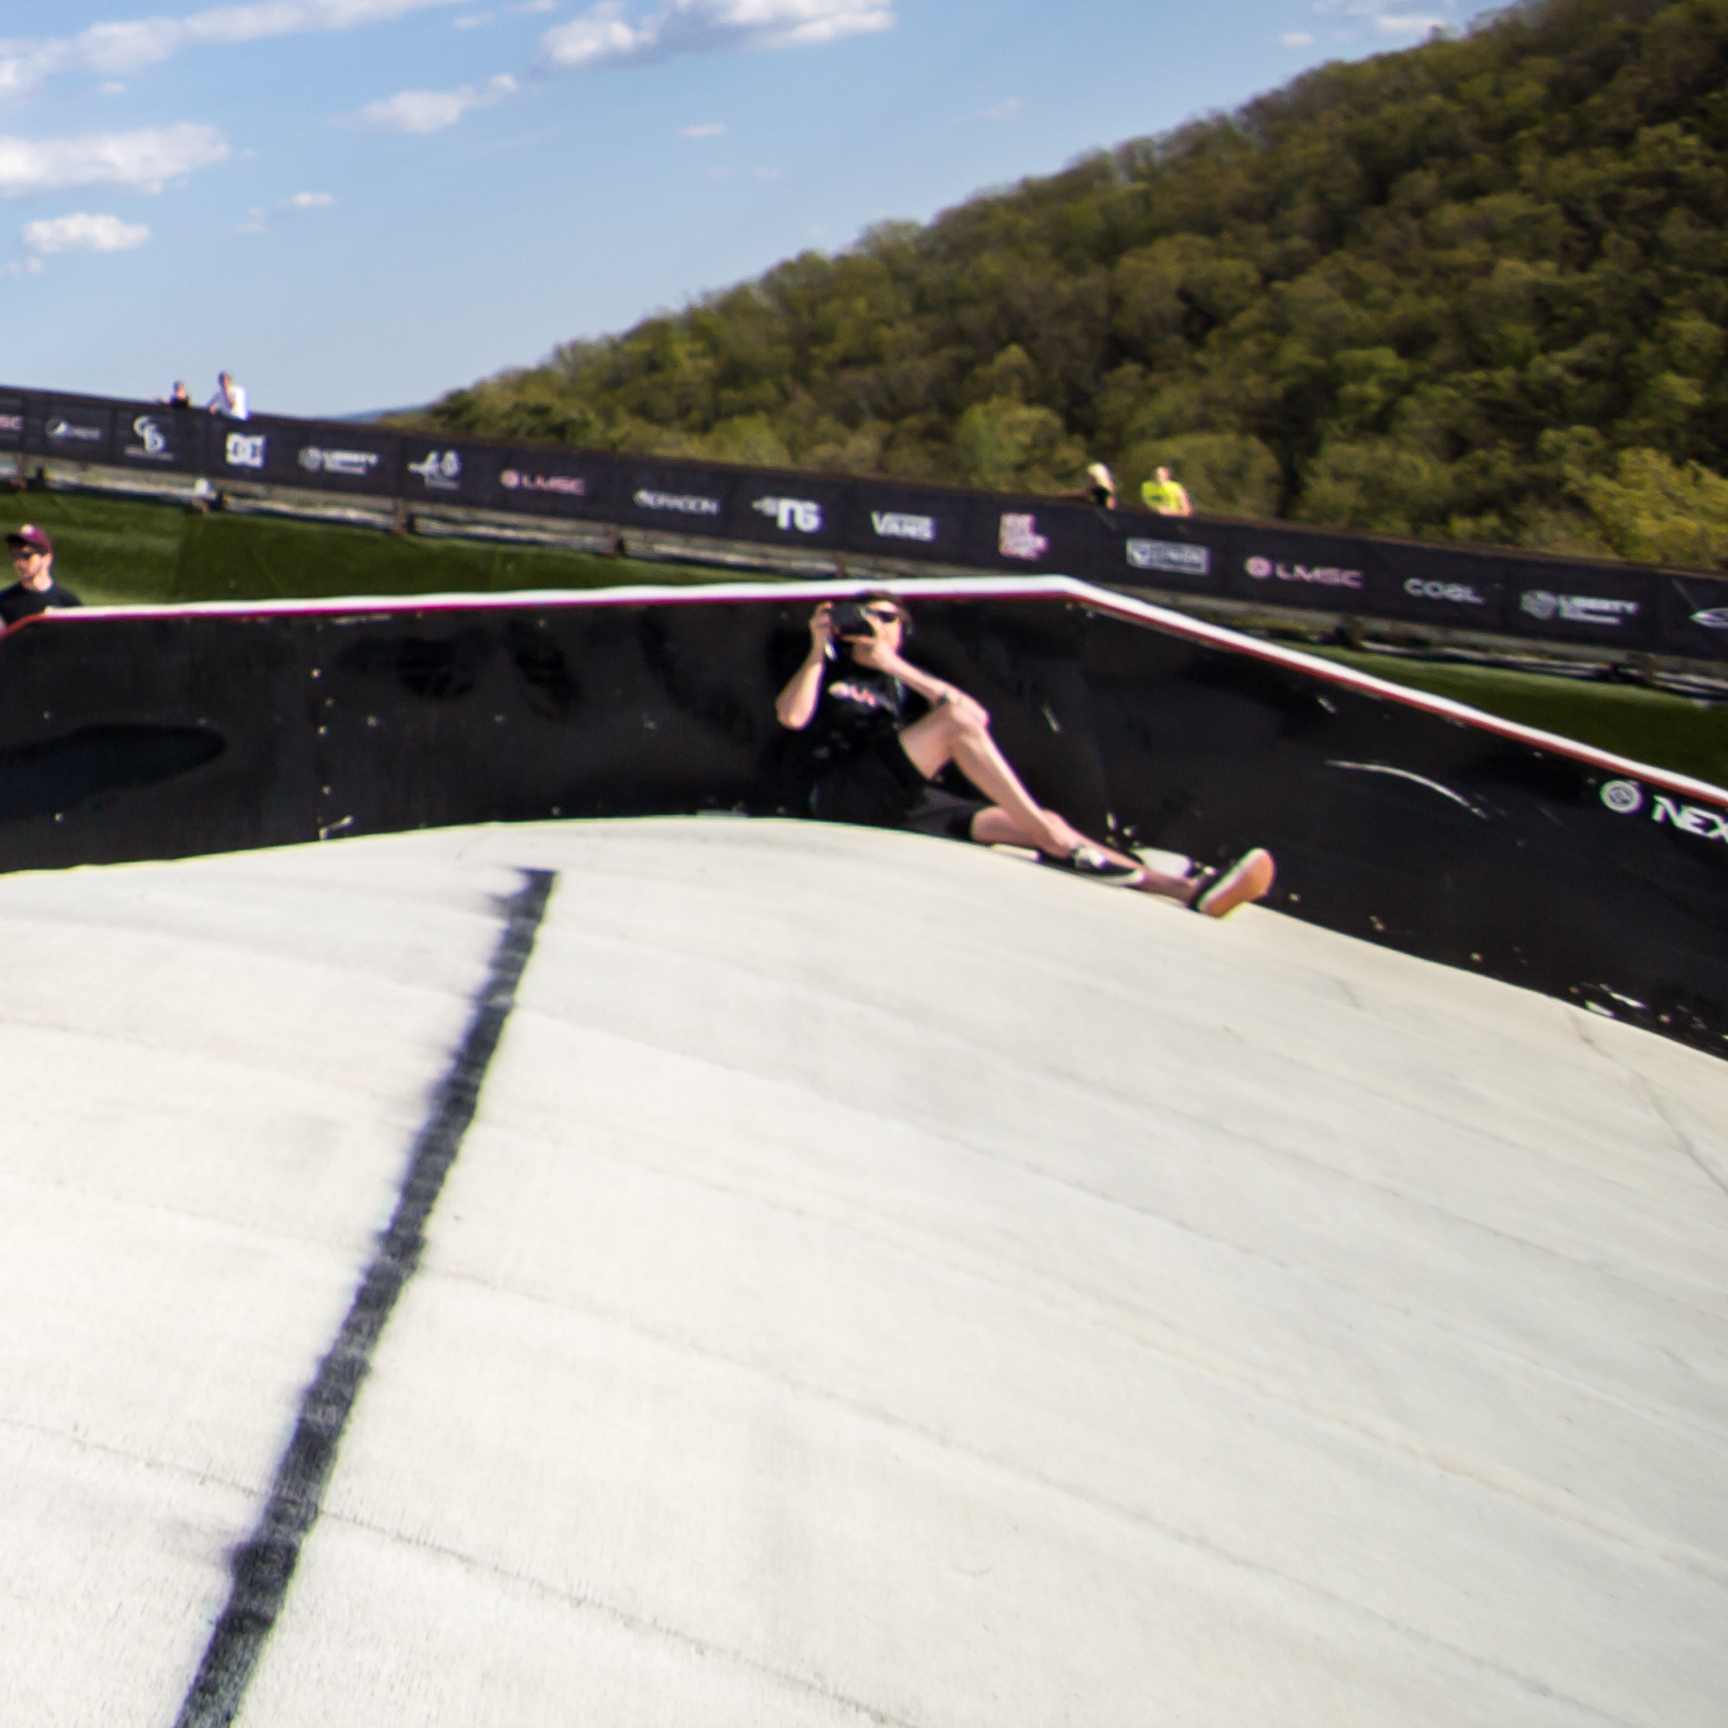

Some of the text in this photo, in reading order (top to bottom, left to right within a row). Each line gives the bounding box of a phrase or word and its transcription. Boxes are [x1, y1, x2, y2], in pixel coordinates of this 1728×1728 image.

[520, 473, 586, 497] LMSC
[870, 510, 935, 543] VANS
[1275, 562, 1367, 589] LMSC
[1403, 577, 1487, 605] COAL
